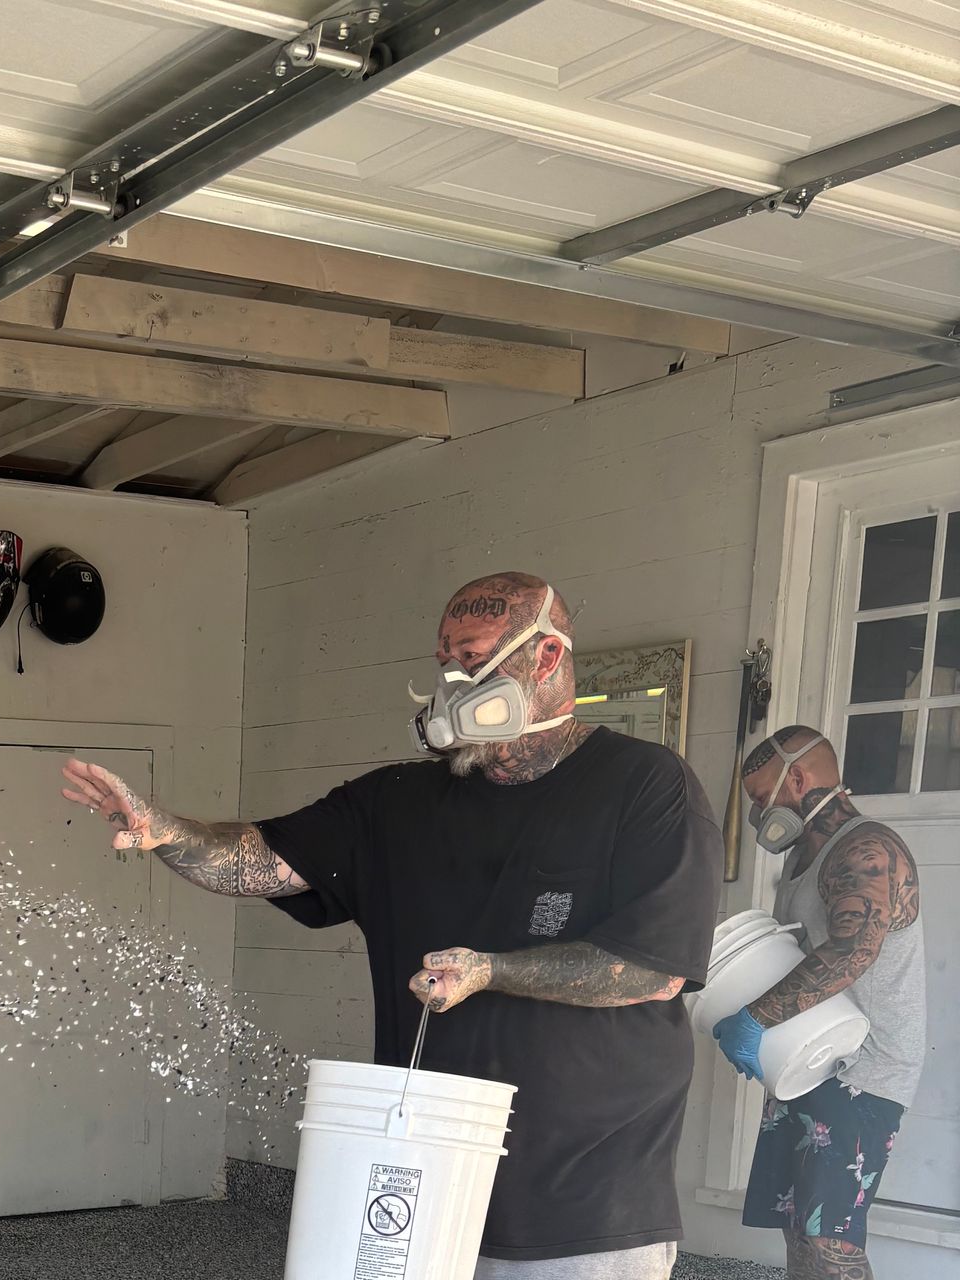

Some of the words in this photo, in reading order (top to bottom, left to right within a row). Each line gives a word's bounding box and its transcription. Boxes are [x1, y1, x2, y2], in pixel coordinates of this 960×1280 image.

[449, 595, 507, 623] GOD
[381, 1167, 420, 1179] WARNING
[387, 1176, 412, 1186] AVISO
